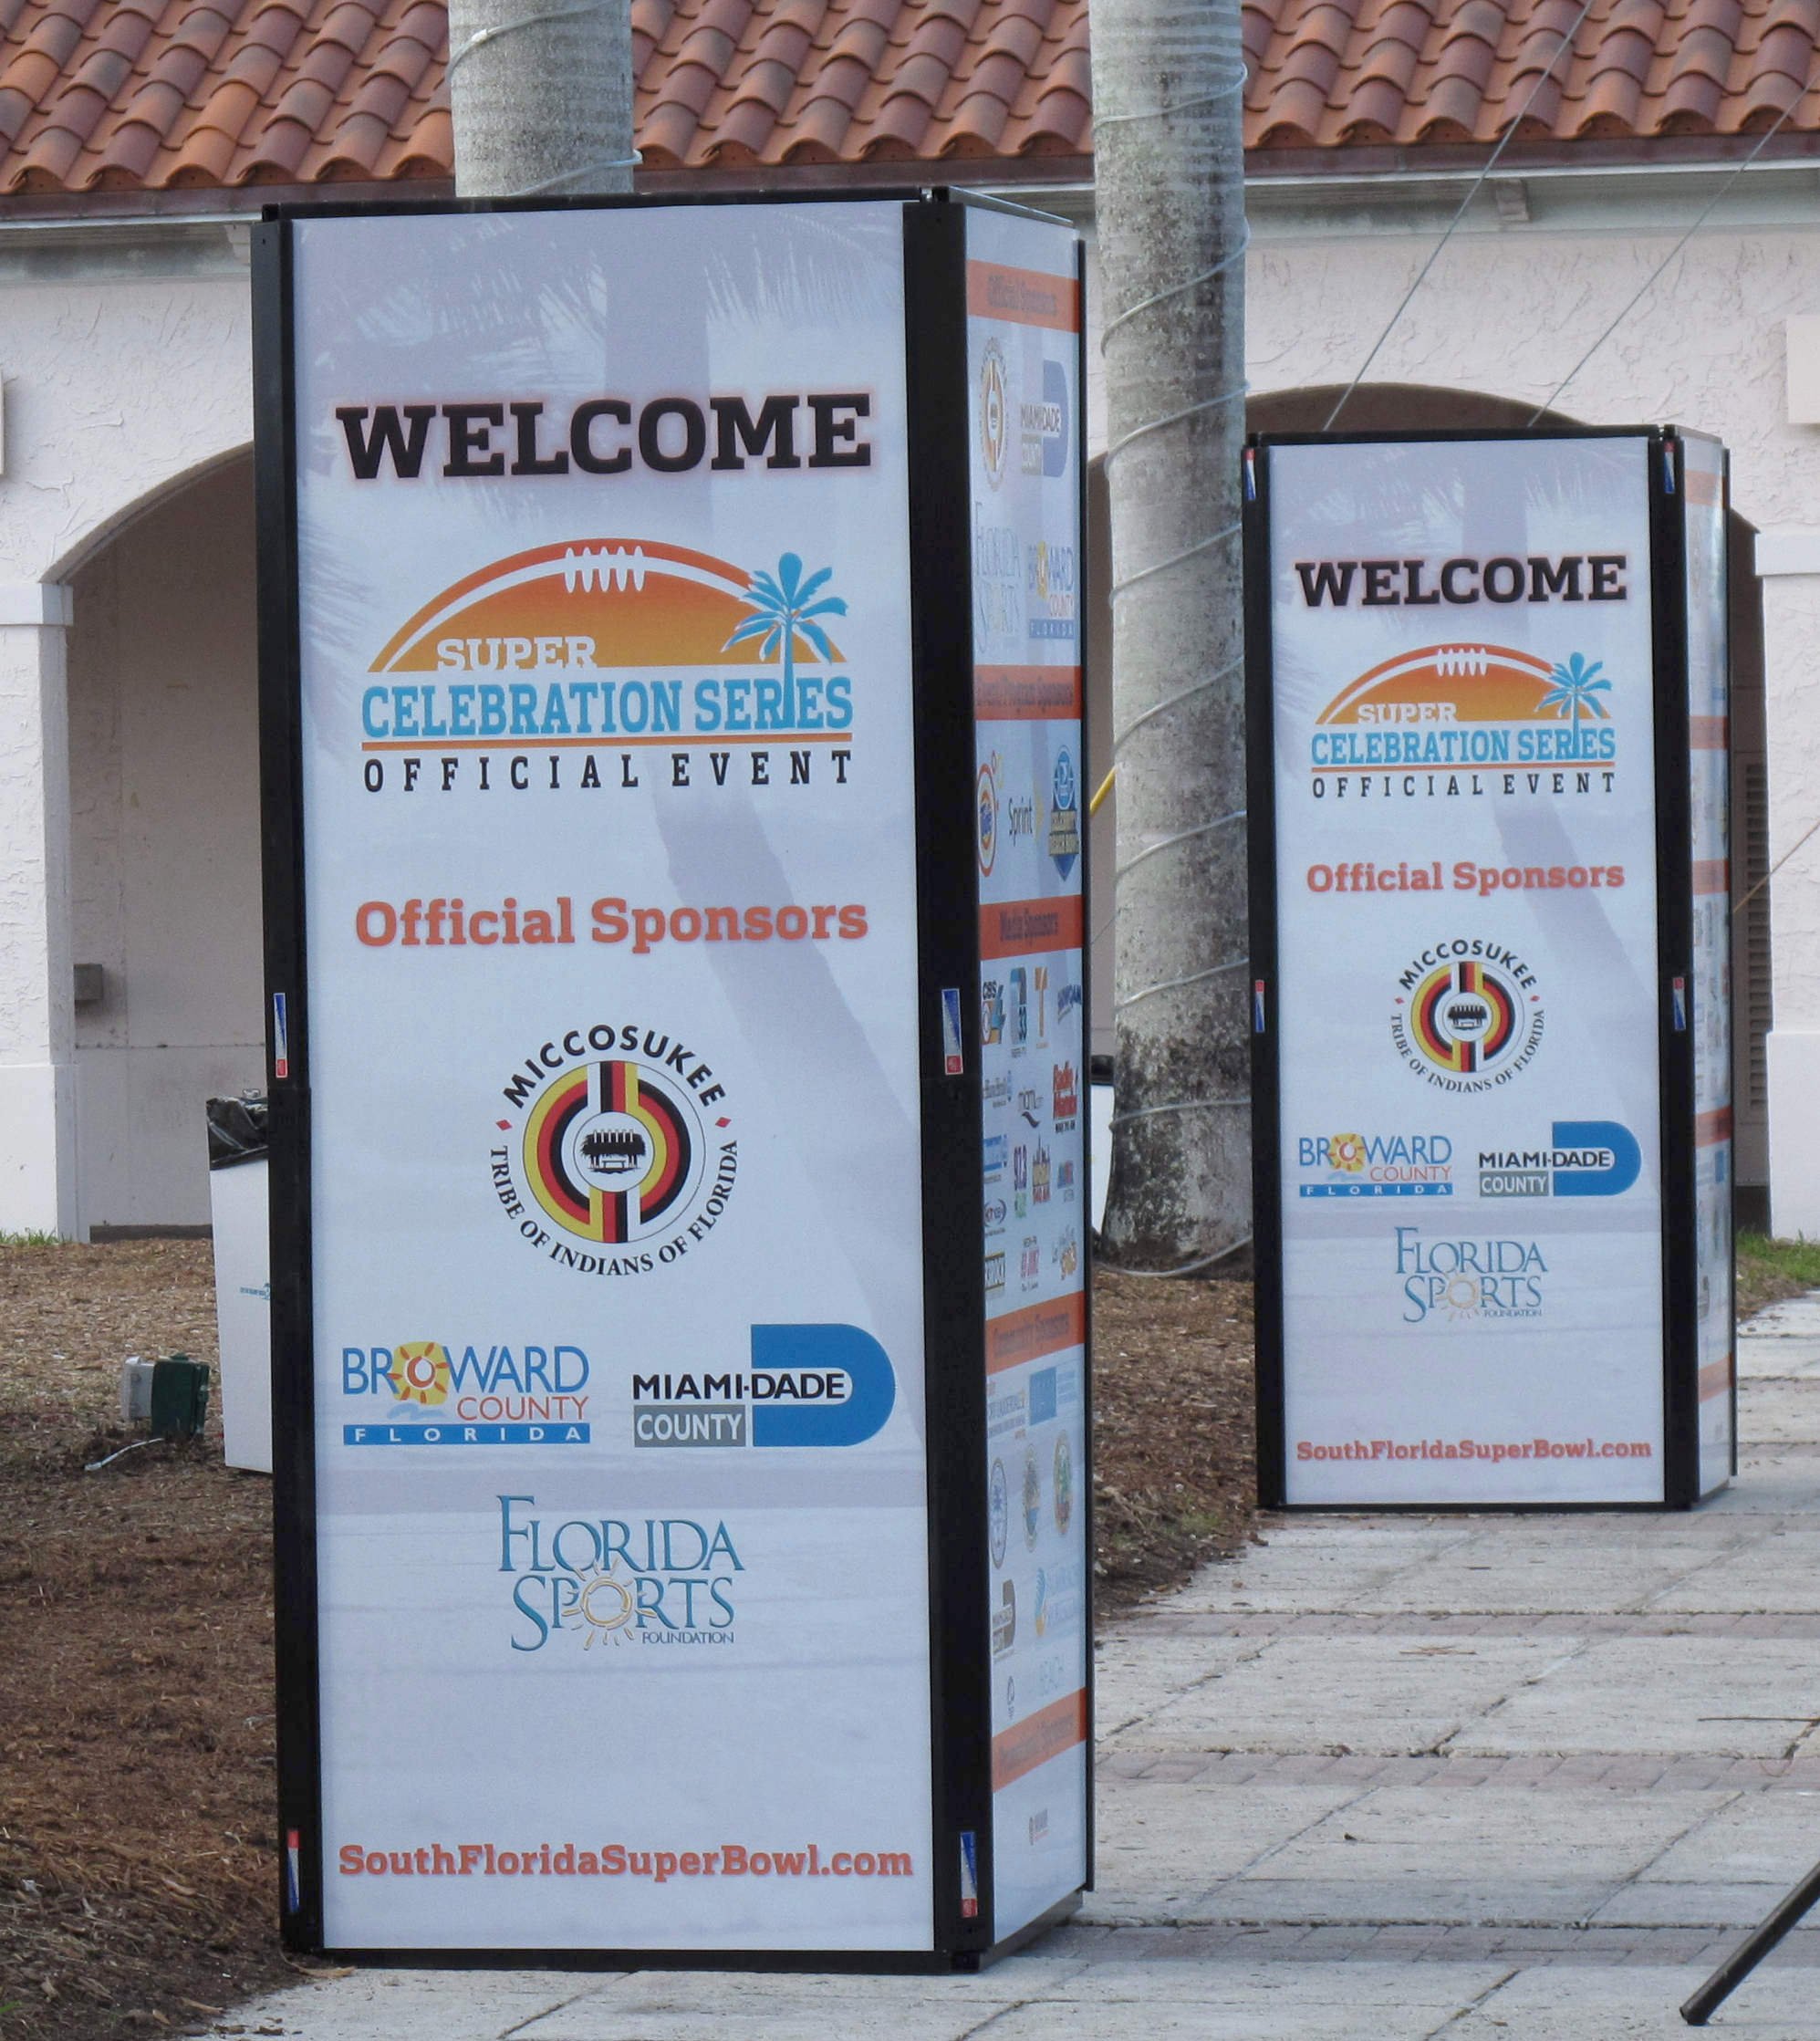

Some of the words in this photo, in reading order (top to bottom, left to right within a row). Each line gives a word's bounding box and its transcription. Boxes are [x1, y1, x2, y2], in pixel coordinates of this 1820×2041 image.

[336, 394, 870, 479] WELCOME
[1295, 556, 1627, 607] WELCOME
[437, 636, 598, 673] SUPER
[362, 681, 682, 738] CELEBRATION
[694, 675, 853, 732] SERIES
[1357, 703, 1457, 723] SUPER
[1311, 731, 1510, 765] CELEBRATION
[1518, 727, 1616, 759] SERIES
[363, 754, 639, 793] OFFICIAL
[671, 750, 851, 786] EVENT
[1312, 774, 1482, 799] OFFICIAL
[1503, 771, 1615, 795] EVENT
[1008, 797, 1033, 847] Sprint
[1306, 860, 1444, 892] Official
[1453, 861, 1625, 897] Sponsors
[356, 897, 575, 947] Official
[591, 897, 868, 953] Sponsors
[1399, 939, 1536, 990] MICCOSUKEE
[983, 980, 996, 1000] CBS
[503, 1024, 726, 1109] MICCOSUKEE
[1390, 1014, 1412, 1058] TRIBE
[1409, 1058, 1428, 1076] OF
[1427, 1071, 1492, 1093] INDIANS
[1494, 1067, 1513, 1085] OF
[1513, 1010, 1544, 1070] FLORIDA
[1299, 1133, 1451, 1168] BROWARD
[1479, 1149, 1611, 1170] MIAMI-DADE
[1305, 1185, 1449, 1196] FLORIDA
[1370, 1166, 1451, 1182] COUNTY
[1482, 1174, 1548, 1195] COUNTY
[490, 1145, 526, 1220] TRIBE
[519, 1220, 551, 1248] OF
[548, 1242, 654, 1276] INDIANS
[659, 1235, 688, 1264] OF
[686, 1140, 738, 1242] FLORIDA
[1395, 1227, 1548, 1275] FLORIDA
[1403, 1276, 1542, 1322] SPORTS
[342, 1343, 589, 1396] BROWARD
[632, 1372, 846, 1401] MIAMI-DADE
[457, 1396, 588, 1421] COUNTY
[637, 1412, 743, 1441] COUNTY
[354, 1427, 581, 1443] FLORIDA
[1297, 1439, 1652, 1463] SouthFloridaSuperBowl.com
[496, 1494, 744, 1573] FLORIDA
[511, 1574, 735, 1651] SPORTS
[642, 1632, 734, 1644] FOUNDATION
[338, 1843, 913, 1882] SouthFloridaSuperBowl.com
